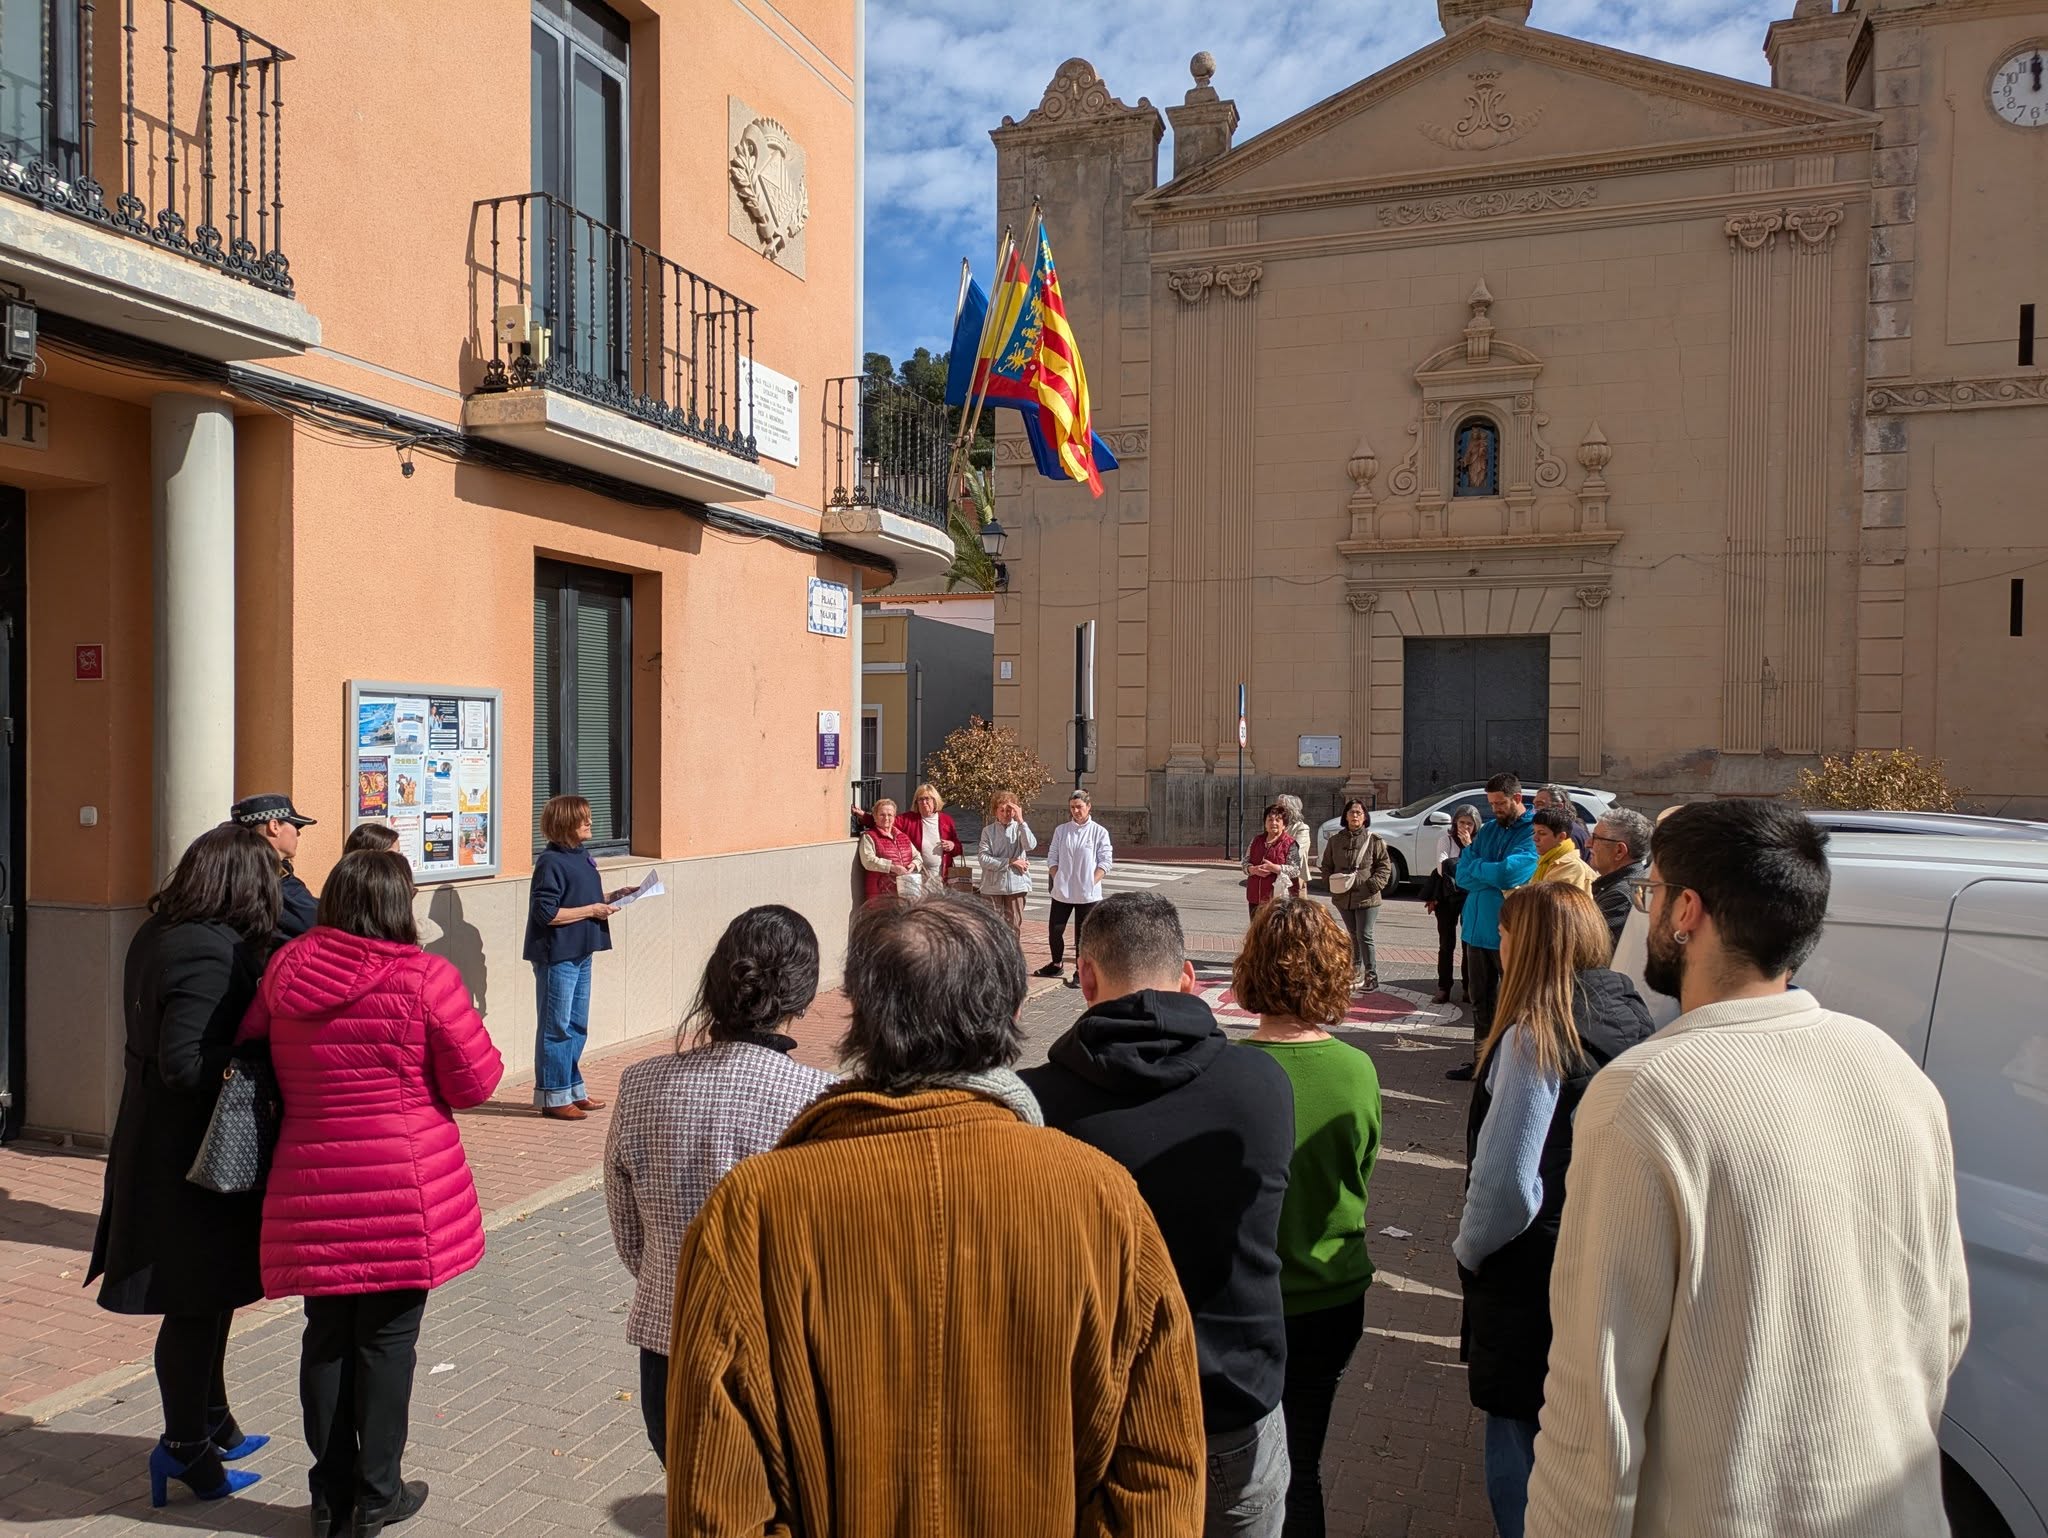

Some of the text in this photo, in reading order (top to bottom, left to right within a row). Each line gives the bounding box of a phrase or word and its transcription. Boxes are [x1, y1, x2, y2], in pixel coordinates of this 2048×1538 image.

[2018, 61, 2027, 74] 11
[2006, 72, 2018, 85] 10
[2003, 84, 2012, 98] 9
[2006, 97, 2016, 109] 8
[2016, 105, 2026, 118] 7
[2030, 106, 2040, 119] 6
[821, 595, 836, 606] PLAÇA
[820, 610, 836, 620] MAJOR
